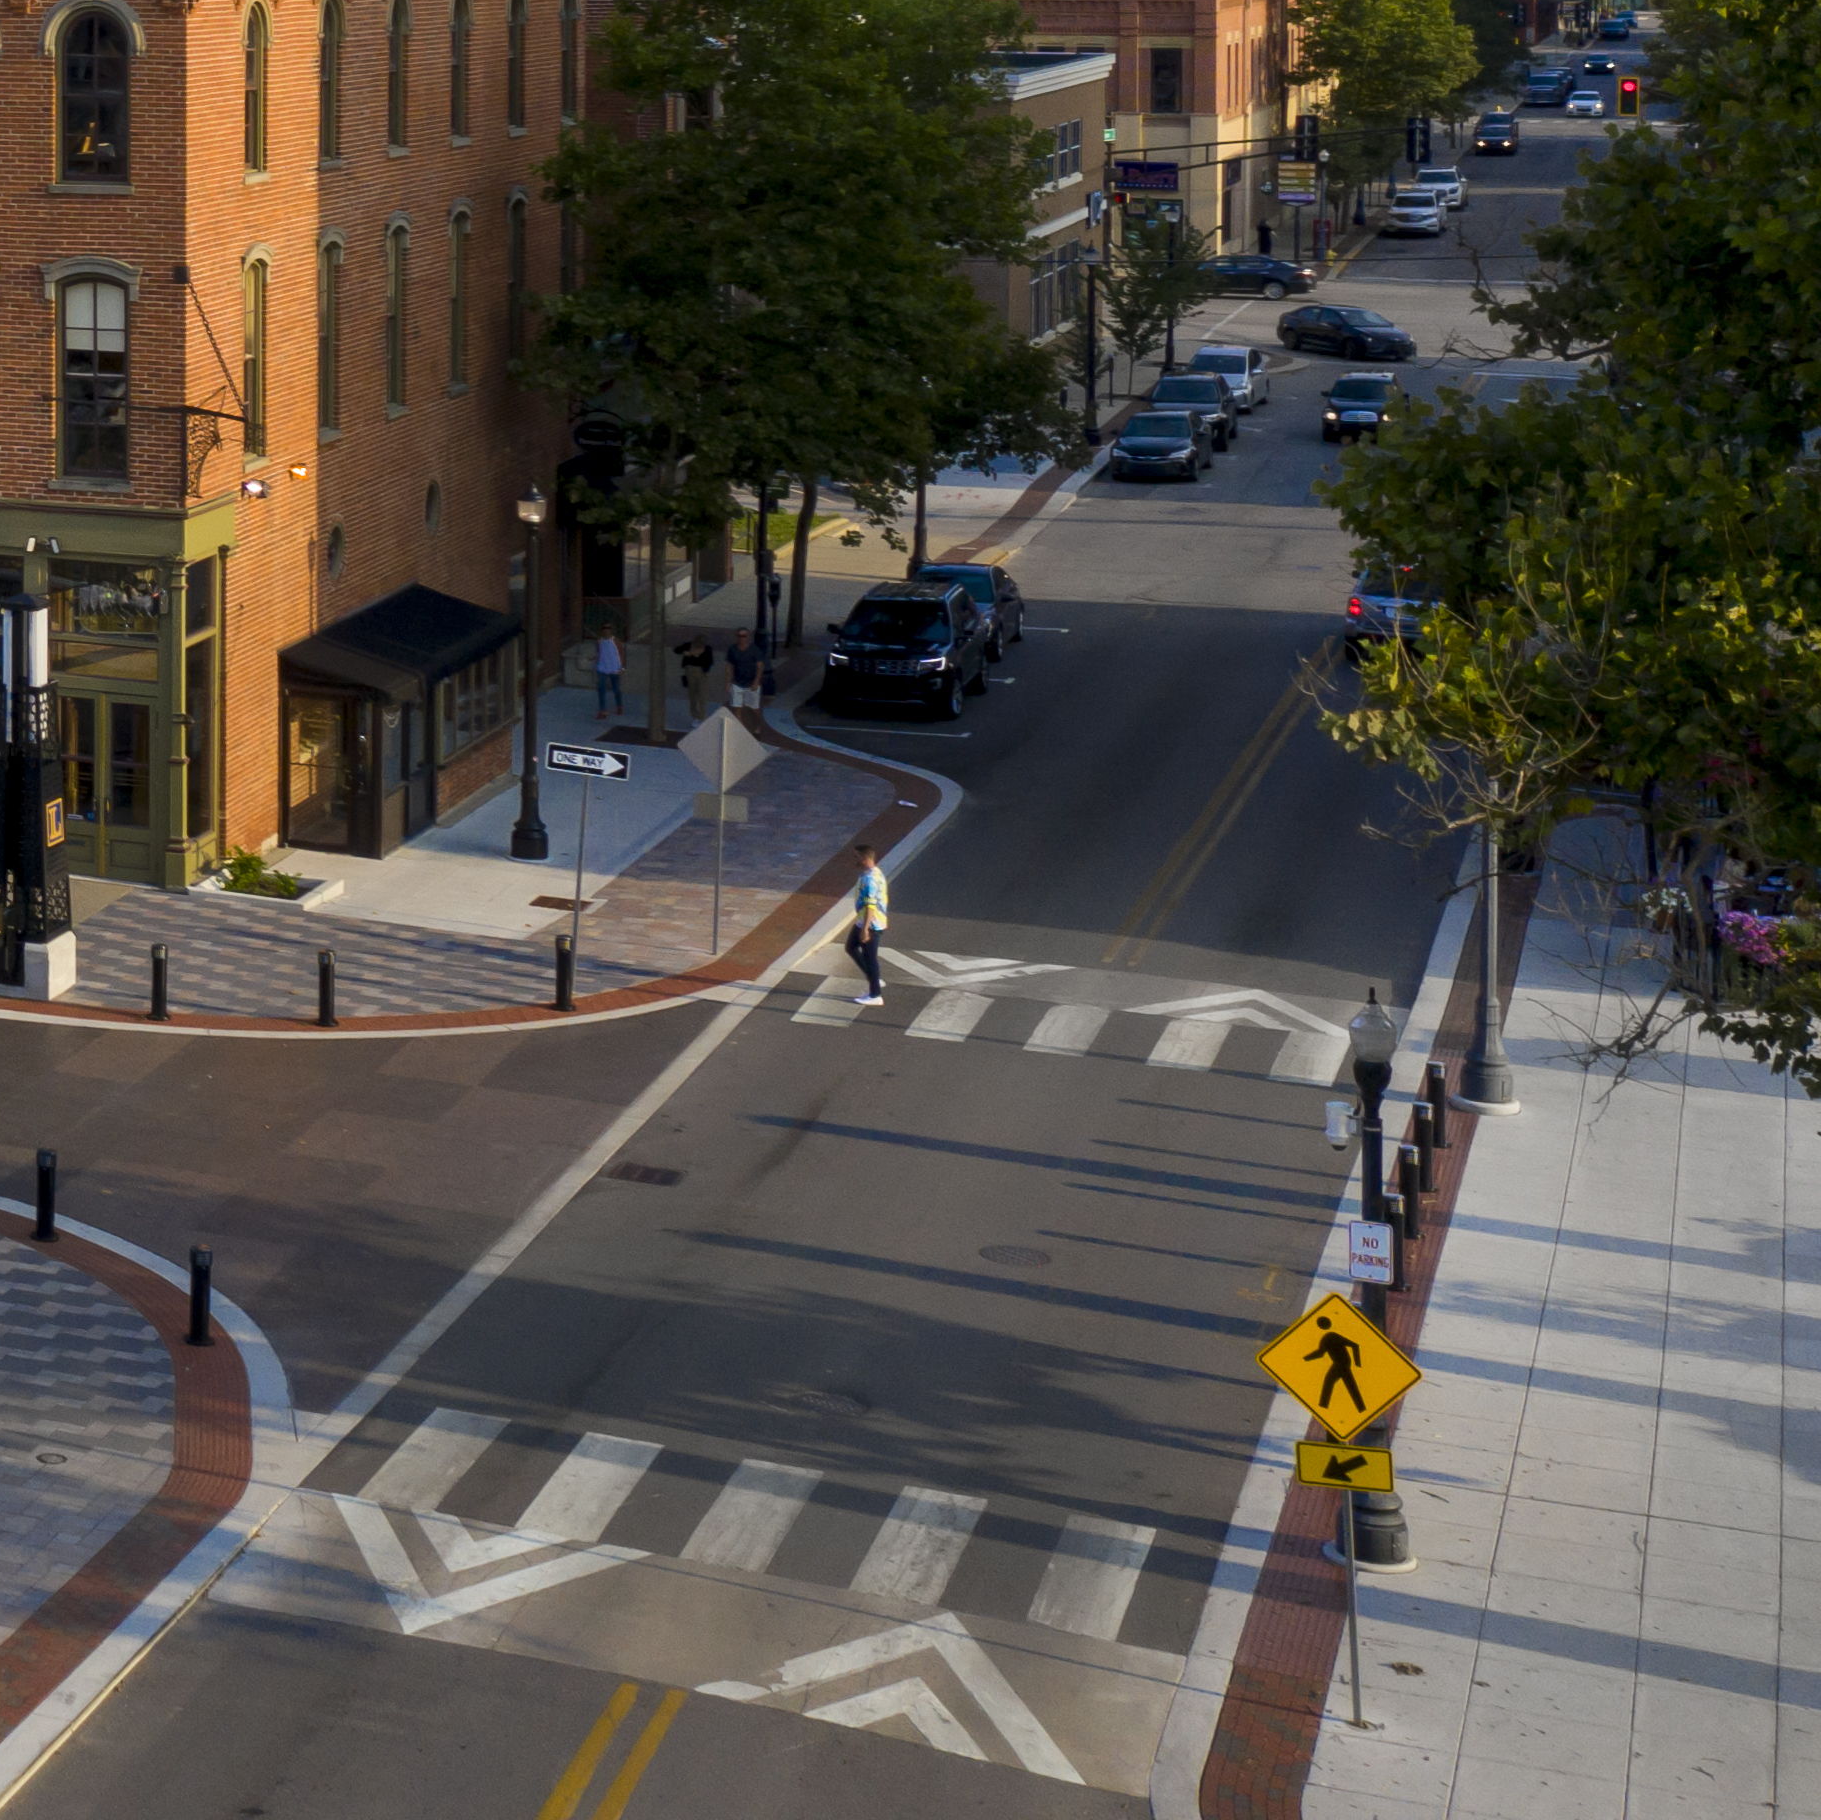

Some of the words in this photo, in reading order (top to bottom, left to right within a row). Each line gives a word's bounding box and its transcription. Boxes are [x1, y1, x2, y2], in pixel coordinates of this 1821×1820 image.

[556, 752, 578, 764] ONE
[582, 756, 604, 768] WAY
[1362, 1237, 1379, 1249] NO
[1352, 1252, 1389, 1268] PARKING
